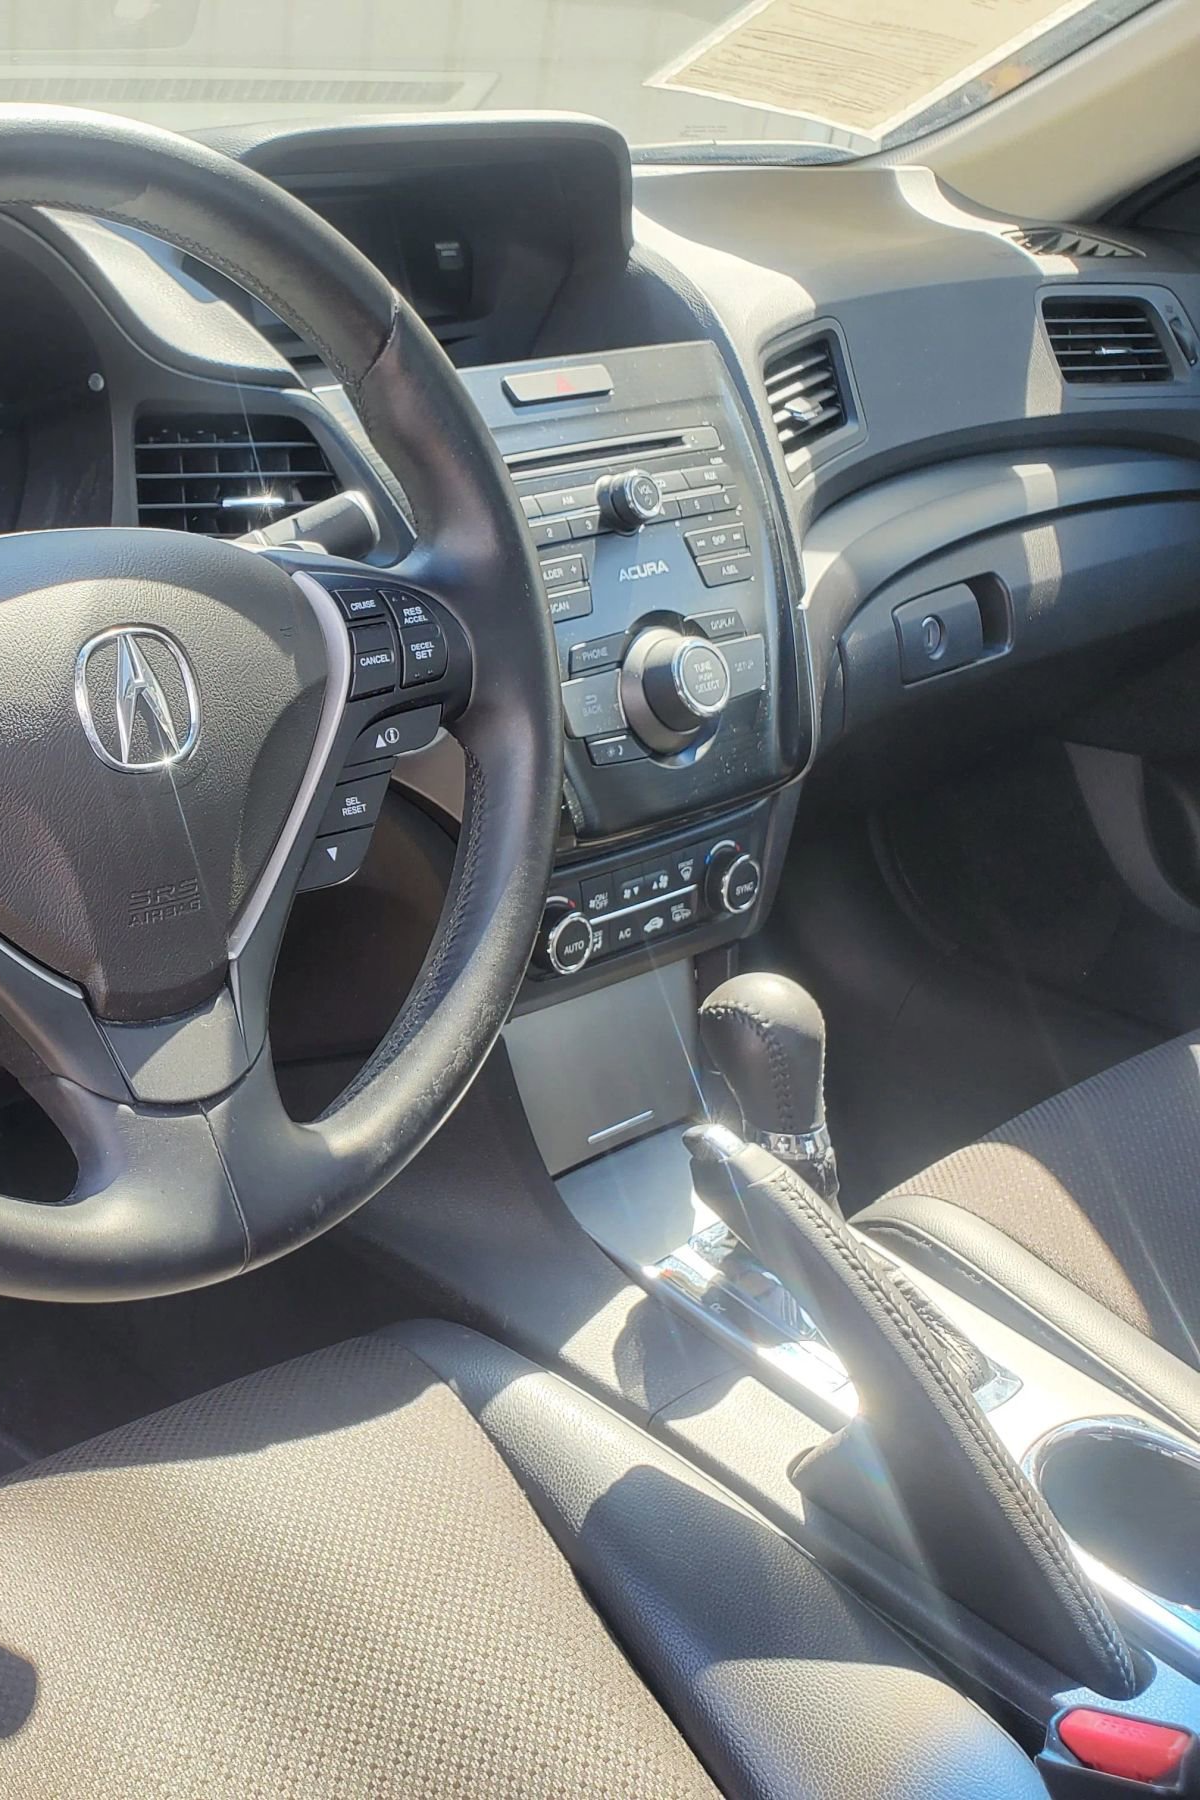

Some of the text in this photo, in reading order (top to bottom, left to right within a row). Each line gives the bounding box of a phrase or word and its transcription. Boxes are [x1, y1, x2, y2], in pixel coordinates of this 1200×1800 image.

[585, 520, 593, 530] 3
[546, 528, 553, 537] 2
[619, 560, 669, 582] ACURA
[350, 600, 376, 611] CRUISE
[403, 606, 423, 617] RES
[404, 615, 428, 625] ACCEL
[410, 641, 435, 652] DECEL
[415, 649, 433, 660] SET
[582, 646, 608, 661] PHONE
[360, 653, 390, 667] CANCEL
[345, 797, 361, 807] SEL
[342, 803, 367, 817] RESET
[129, 878, 199, 906] SRS
[736, 881, 754, 896] SYNC
[596, 899, 609, 910] OFF
[128, 900, 201, 928] AIRBAG
[619, 928, 631, 940] A/C
[564, 940, 585, 956] AUTO
